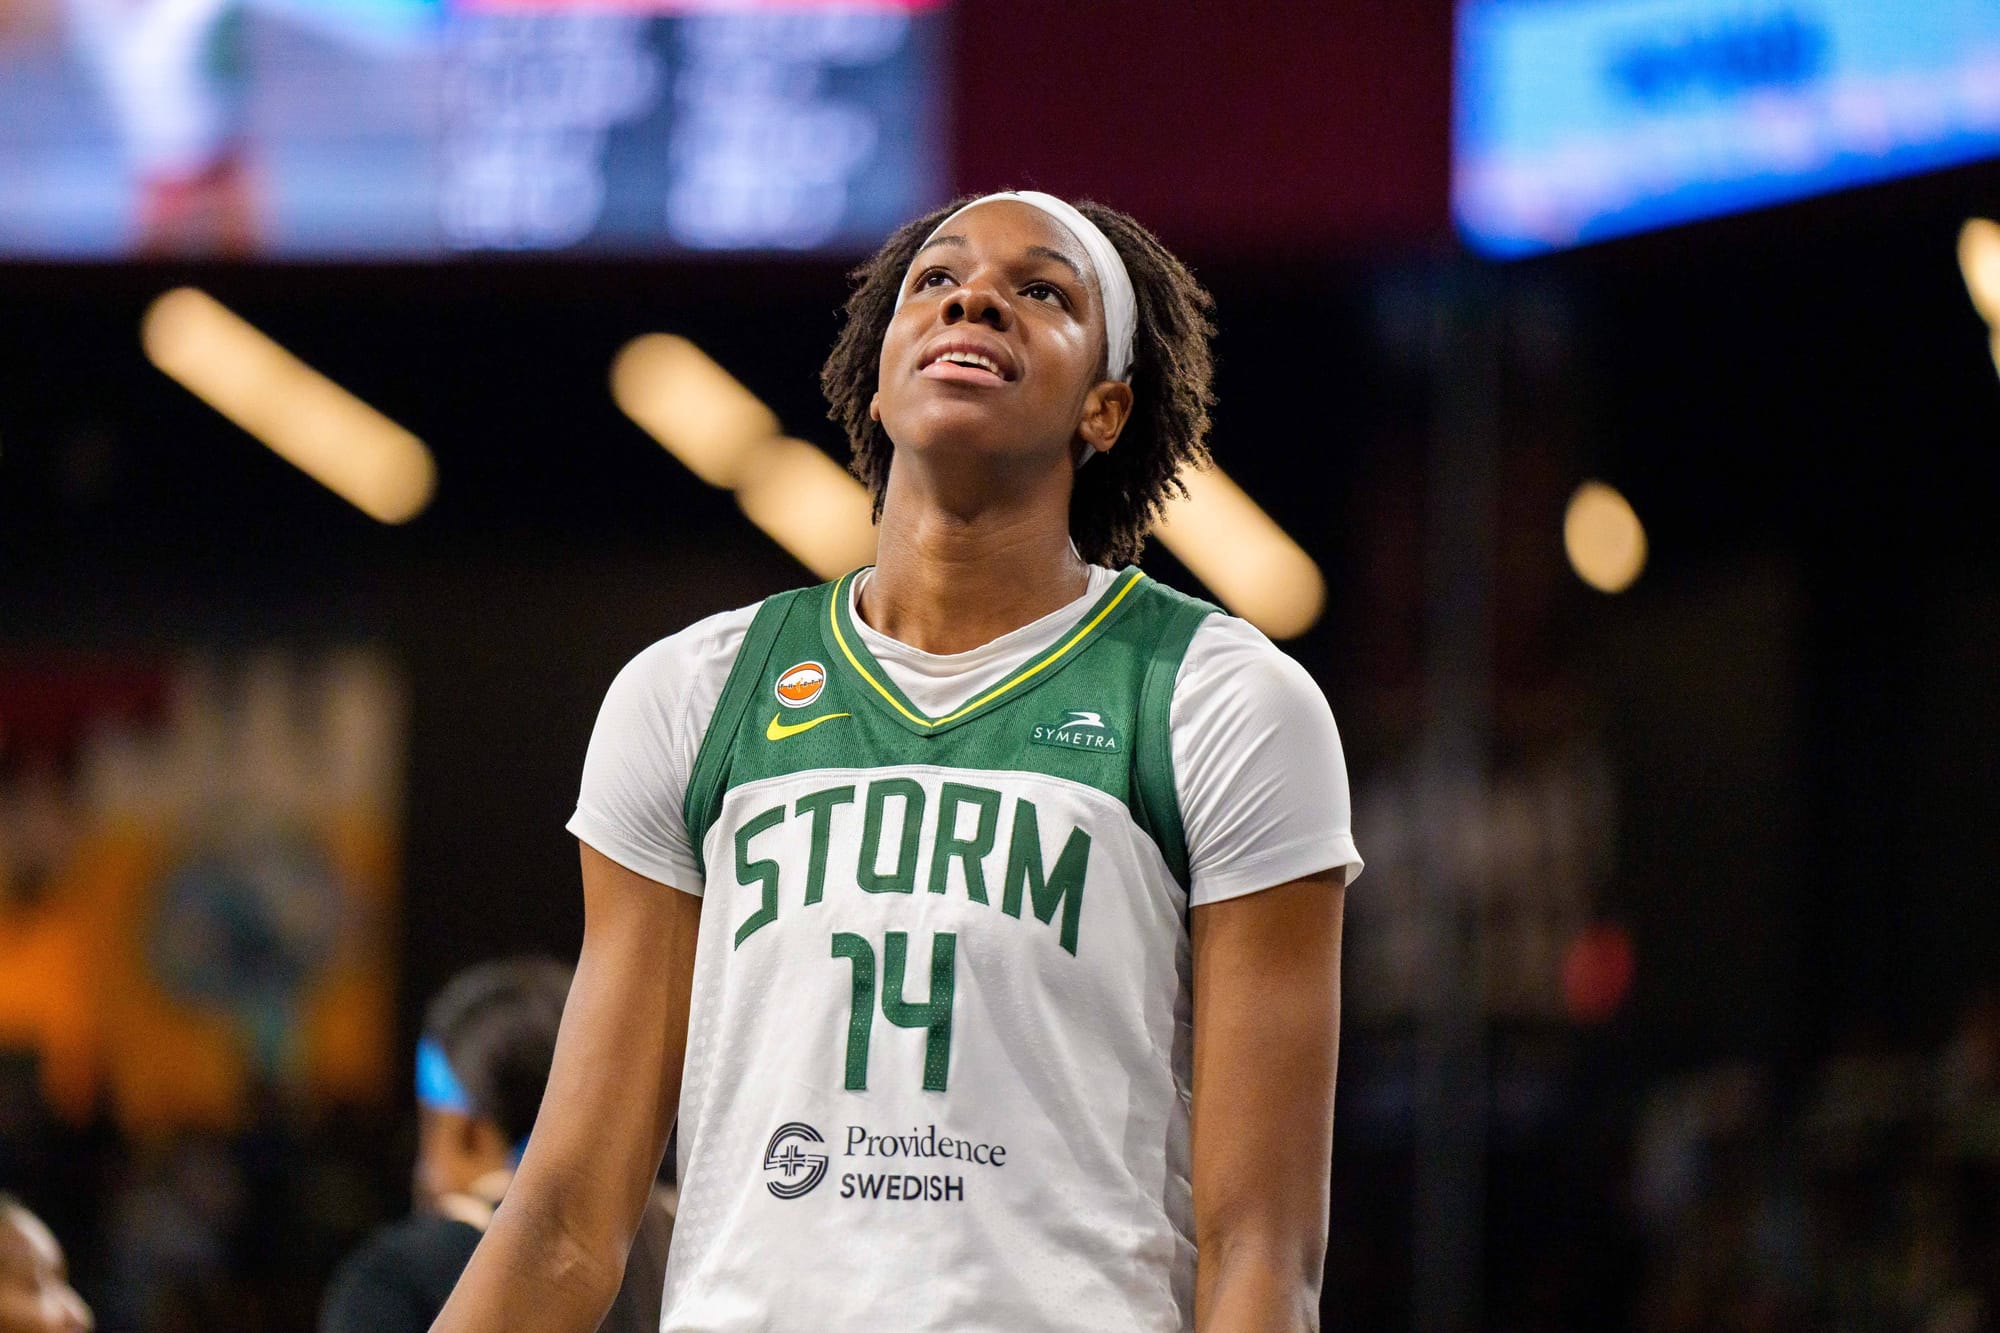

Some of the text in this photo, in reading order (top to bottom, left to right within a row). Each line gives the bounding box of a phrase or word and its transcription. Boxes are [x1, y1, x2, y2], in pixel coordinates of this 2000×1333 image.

[1034, 727, 1116, 748] SYMETRA
[734, 777, 1092, 957] STORM
[831, 931, 957, 1092] 14
[843, 1125, 1007, 1167] Providence
[839, 1173, 964, 1201] SWEDISH
